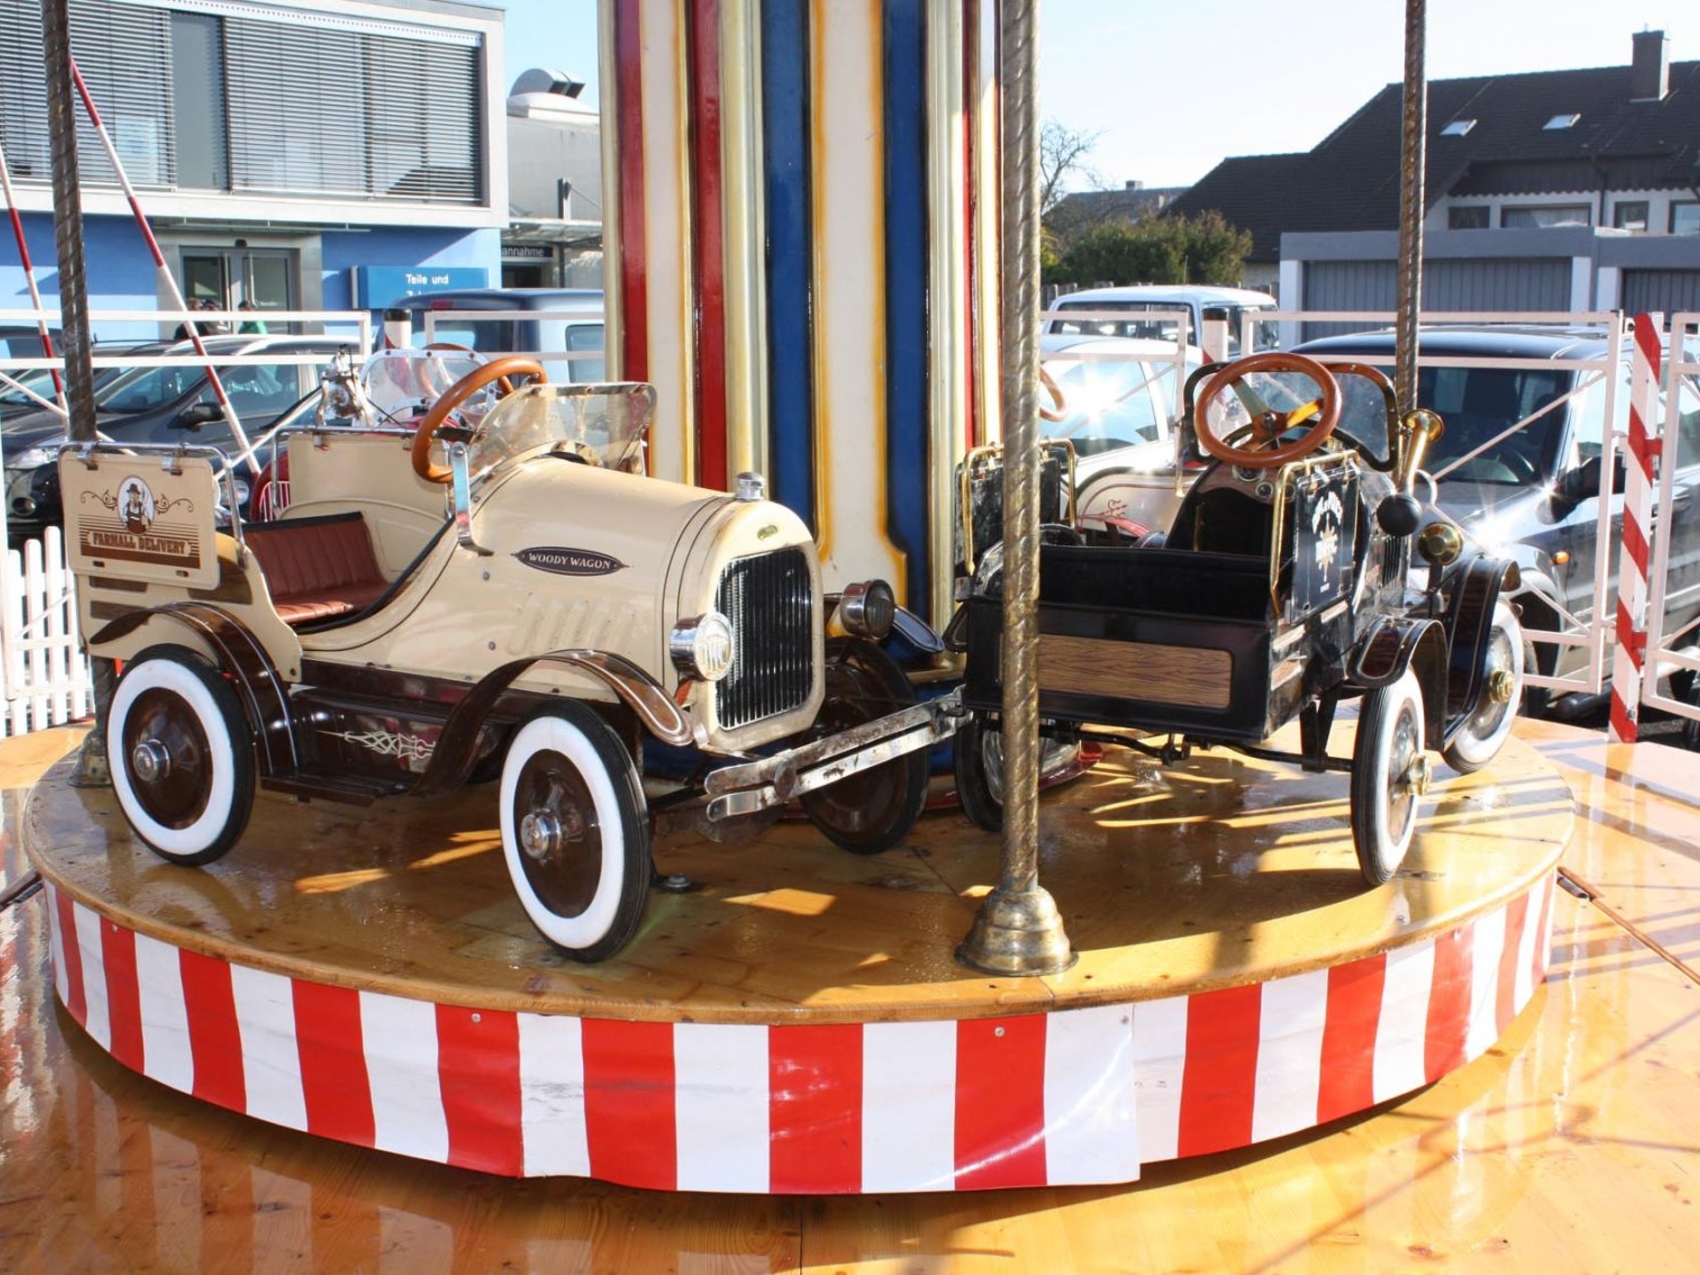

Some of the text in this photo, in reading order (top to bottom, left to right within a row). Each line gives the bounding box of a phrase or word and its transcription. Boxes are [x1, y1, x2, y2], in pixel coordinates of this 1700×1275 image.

[405, 273, 449, 285] Teile und
[92, 532, 186, 554] FARMALL DELIVERY
[528, 552, 611, 569] WOODY WAGON
